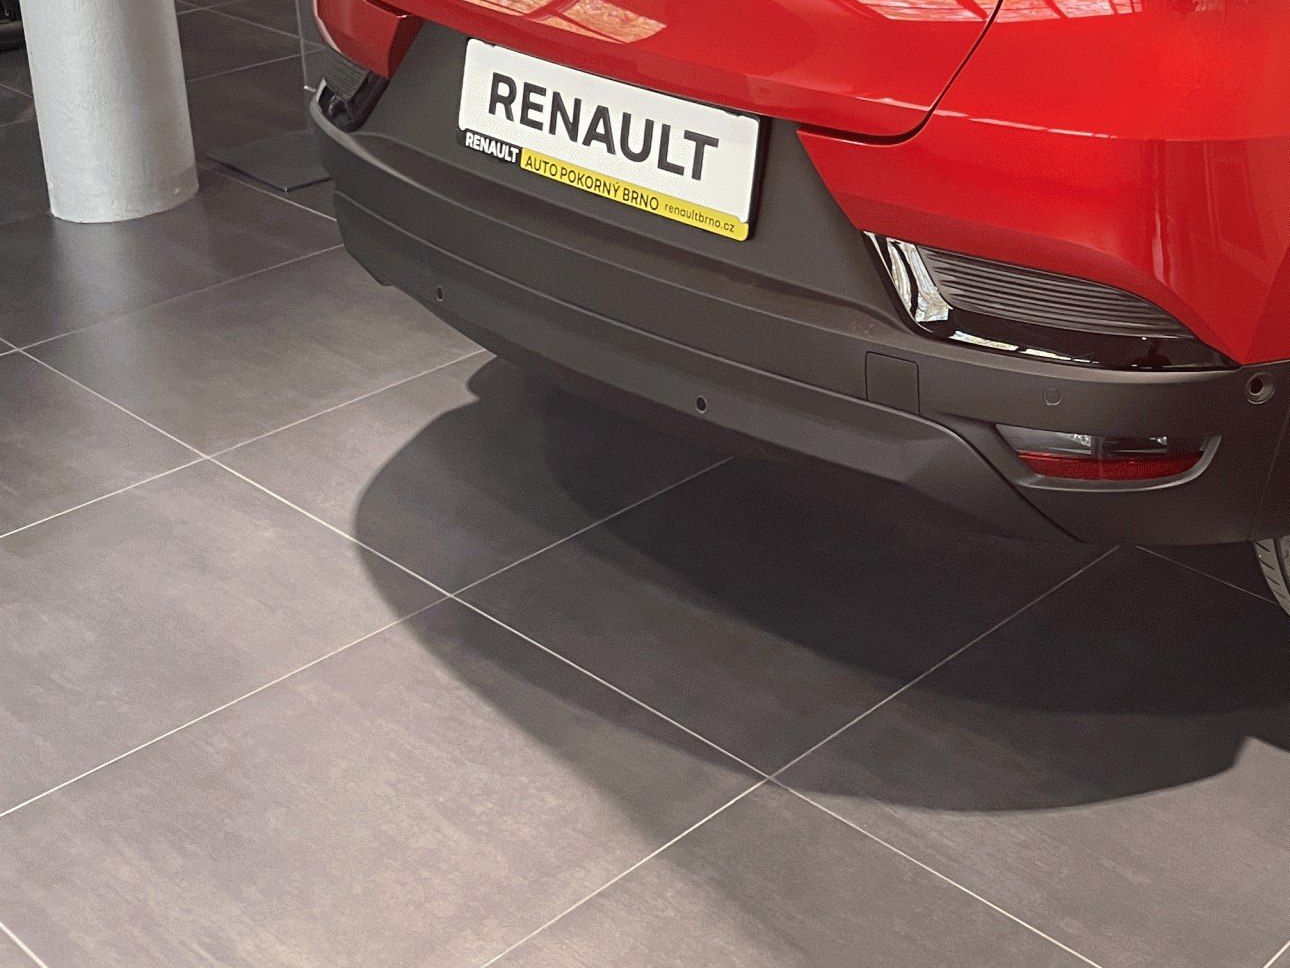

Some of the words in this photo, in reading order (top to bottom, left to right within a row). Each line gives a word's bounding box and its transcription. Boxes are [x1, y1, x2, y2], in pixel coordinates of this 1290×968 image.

[465, 132, 520, 163] RENAULT
[488, 72, 719, 181] RENAULT
[525, 155, 558, 177] AUTO
[560, 167, 621, 198] POKORNÝ
[622, 187, 659, 211] BRNO
[664, 202, 735, 233] renaultbrno.cz
